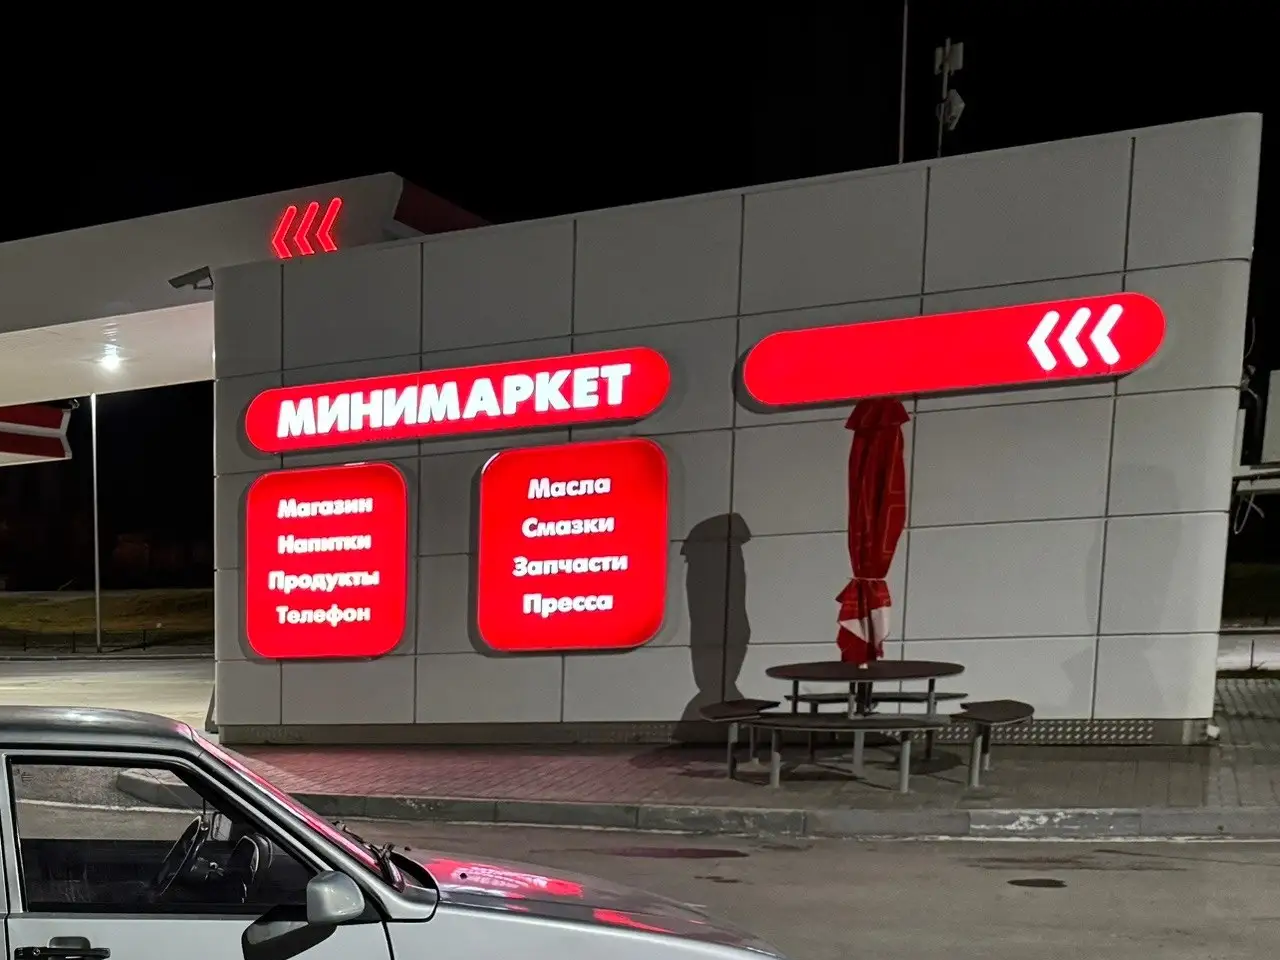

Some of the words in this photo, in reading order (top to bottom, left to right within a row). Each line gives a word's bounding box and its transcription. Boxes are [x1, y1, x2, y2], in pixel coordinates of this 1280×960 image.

[277, 363, 632, 438] МИНИМАРКЕТ
[527, 476, 611, 499] Масла
[277, 498, 373, 518] Магазин
[522, 516, 615, 538] Смазки
[278, 533, 371, 555] Напитки
[512, 554, 628, 577] Запчасти
[268, 570, 380, 592] Продукты
[276, 603, 371, 627] Телефон
[523, 594, 614, 618] Пресса
